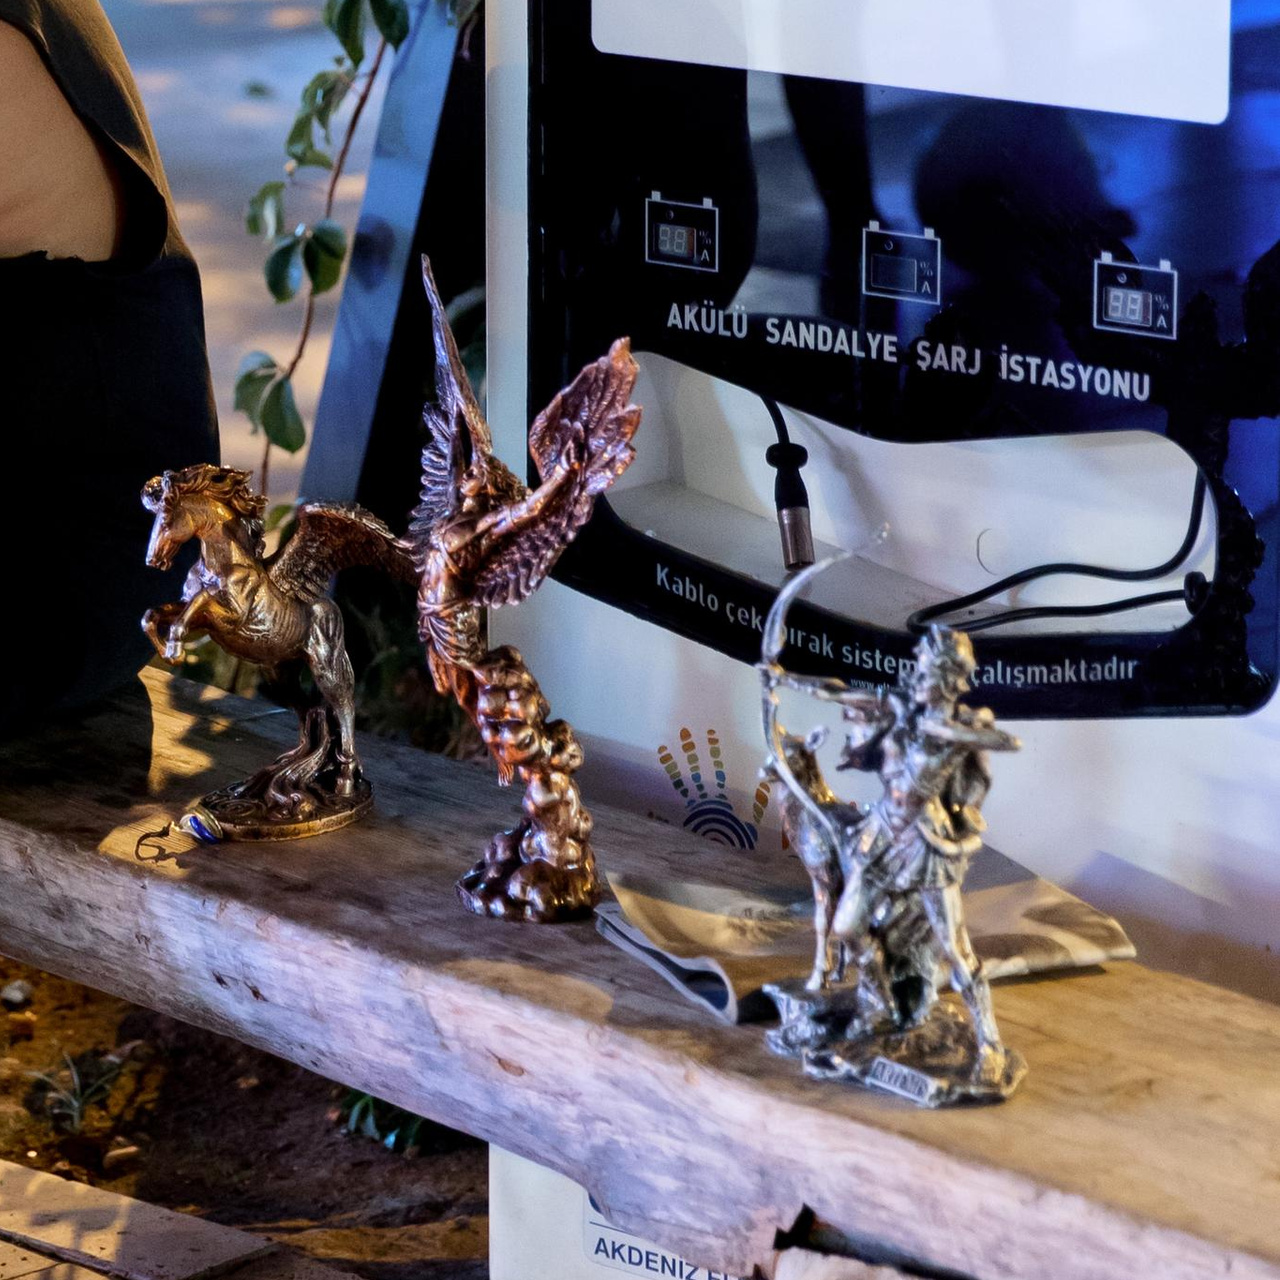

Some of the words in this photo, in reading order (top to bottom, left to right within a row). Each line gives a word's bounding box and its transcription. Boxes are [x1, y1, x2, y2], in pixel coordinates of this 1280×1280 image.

[667, 300, 748, 339] AKÜLÜ
[766, 317, 899, 363] SANDALYE
[916, 340, 982, 375] ŞARJ
[999, 344, 1151, 402] İSTASYONU
[656, 562, 719, 613] Kablo
[971, 655, 1138, 689] çalışmaktadır
